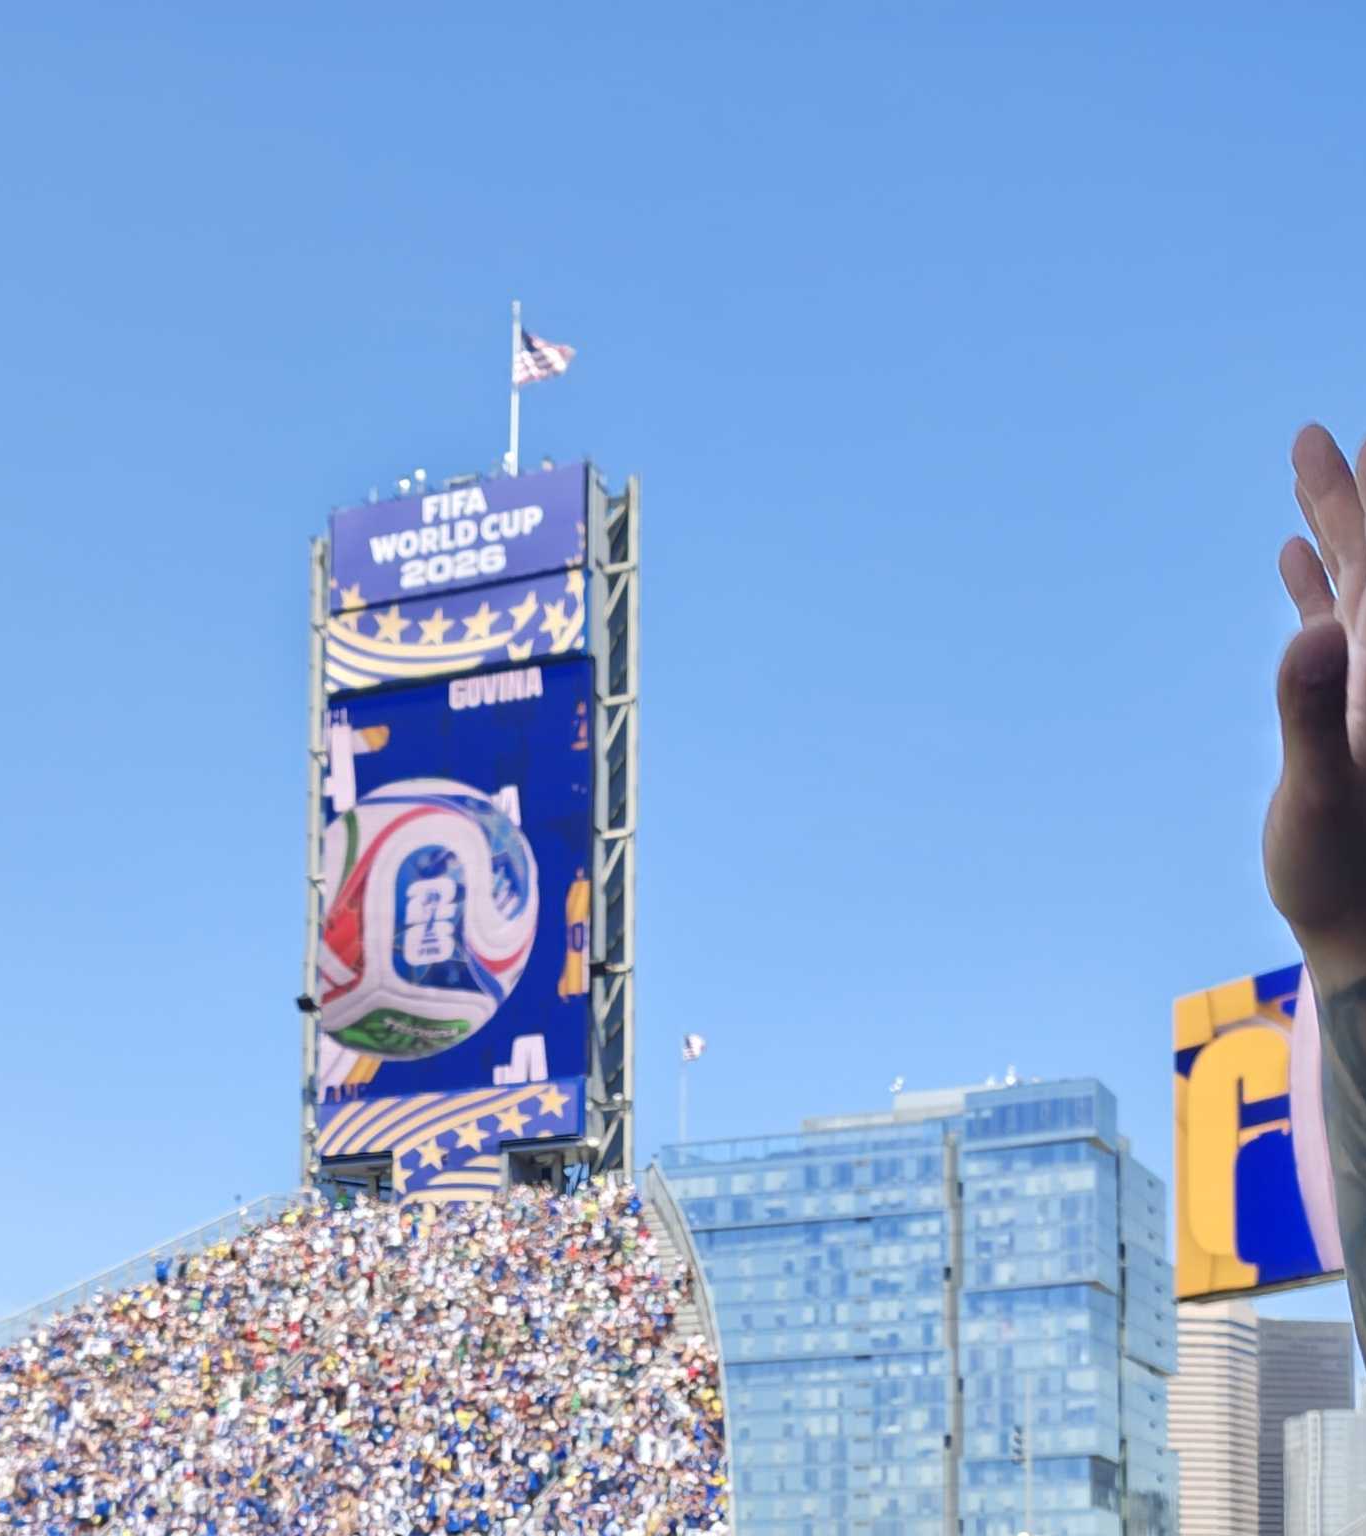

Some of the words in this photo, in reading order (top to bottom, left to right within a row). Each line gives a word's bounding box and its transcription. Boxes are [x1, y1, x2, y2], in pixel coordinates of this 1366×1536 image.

[422, 487, 487, 523] FIFA
[369, 519, 480, 565] WORLD
[480, 505, 543, 540] CUP
[399, 544, 507, 589] 2026
